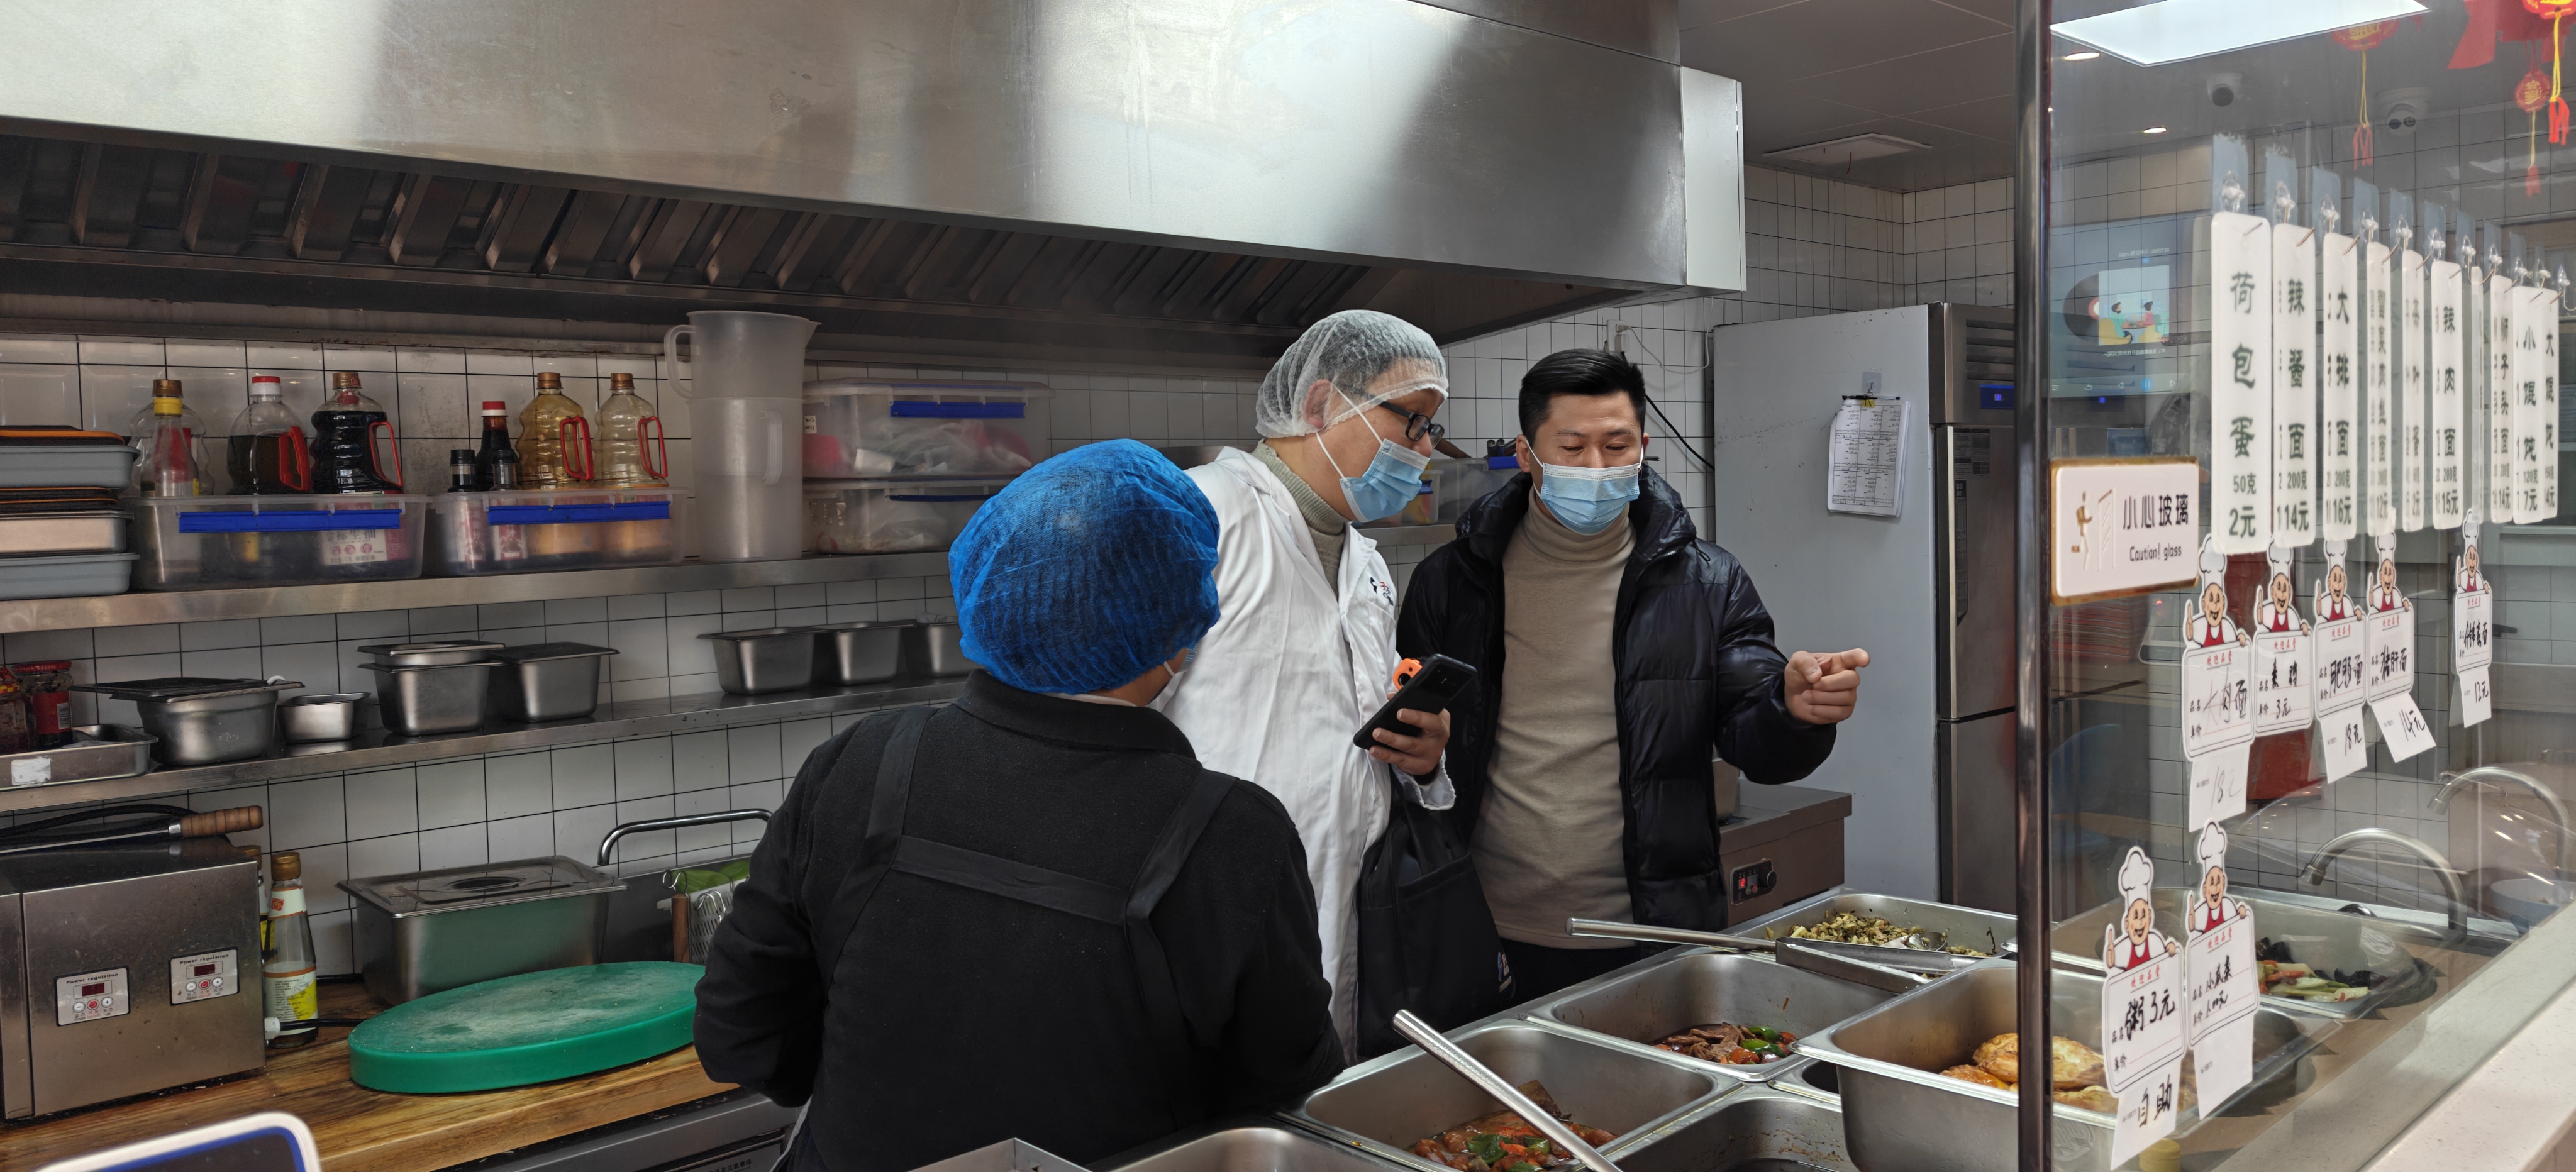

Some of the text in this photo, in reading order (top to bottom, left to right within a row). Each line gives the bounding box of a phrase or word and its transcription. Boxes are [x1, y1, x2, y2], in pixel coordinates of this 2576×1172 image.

[2230, 272, 2255, 458] 荷包蛋
[2288, 279, 2305, 459] 辣酱面
[2336, 285, 2350, 458] 大排面
[2443, 304, 2456, 457] 辣肉面
[2523, 325, 2537, 462] 小馄饨
[2233, 473, 2257, 495] 50克
[2287, 470, 2307, 489] 200克
[2443, 465, 2457, 483] 200克
[2524, 469, 2538, 484] 120克
[2123, 494, 2189, 530] 小心玻璃
[2333, 496, 2352, 526] 16元
[2442, 489, 2458, 515] 15元
[2524, 489, 2538, 511] 7元
[2229, 506, 2256, 538] 2元
[2285, 501, 2309, 531] 14元
[2129, 543, 2182, 561] Caution! glass
[2276, 698, 2291, 719] 3元
[2138, 1074, 2172, 1127] 自助
